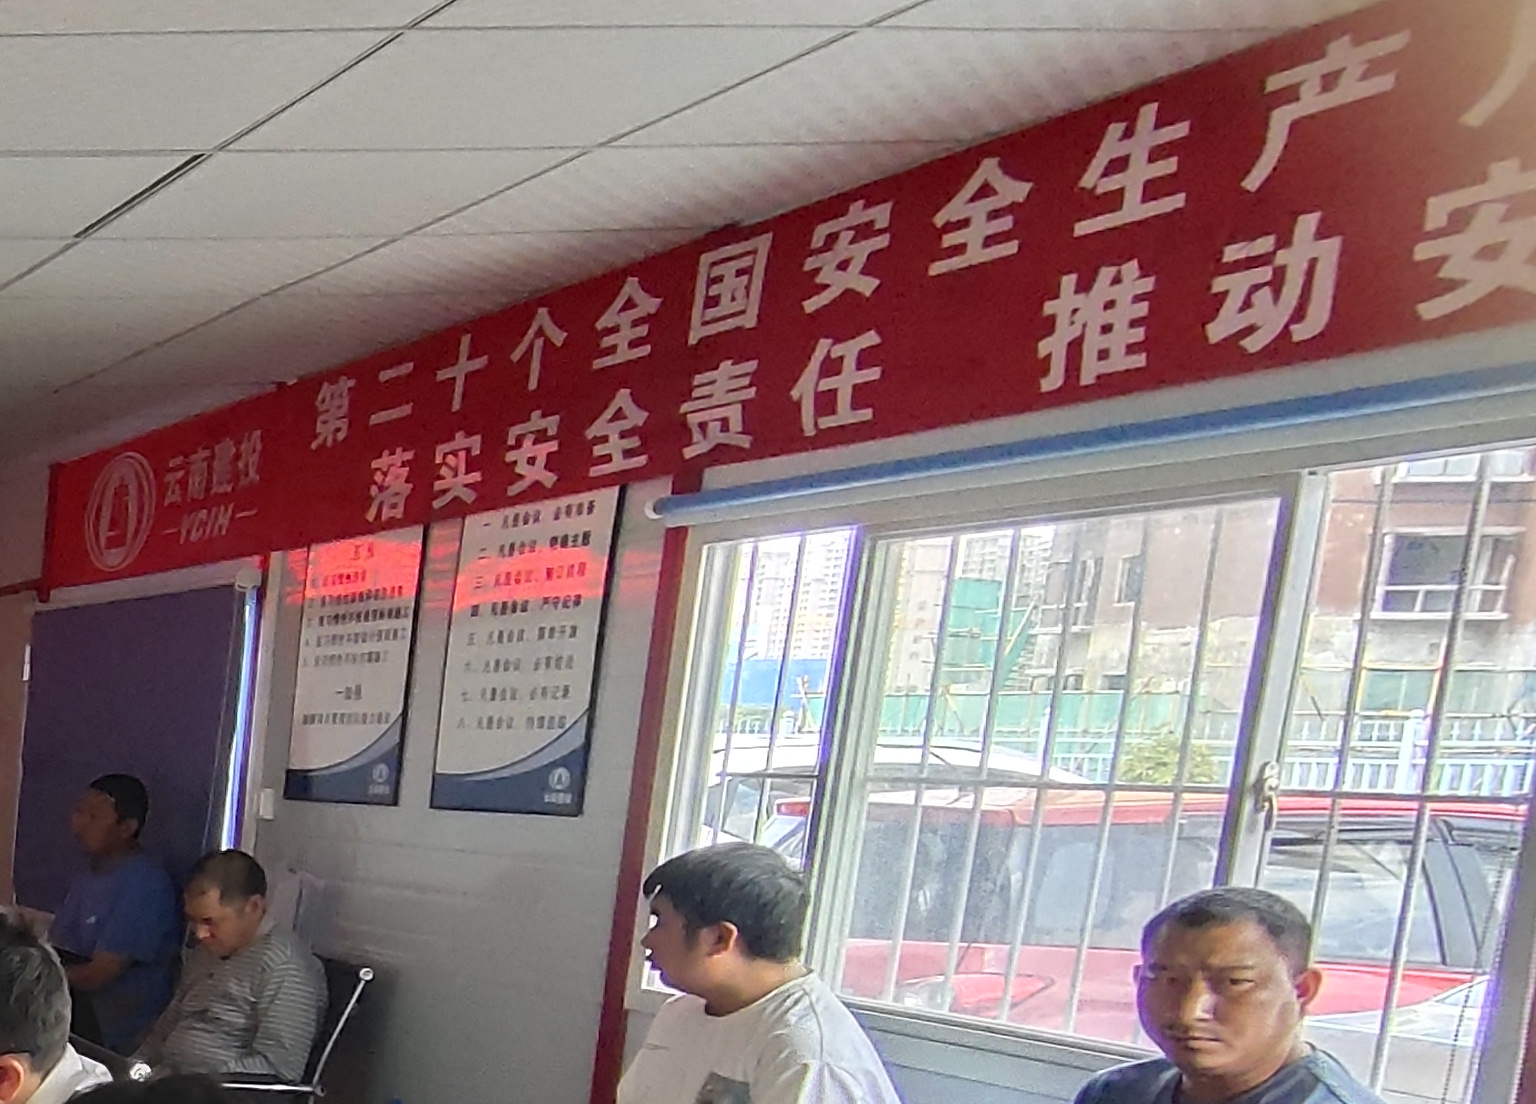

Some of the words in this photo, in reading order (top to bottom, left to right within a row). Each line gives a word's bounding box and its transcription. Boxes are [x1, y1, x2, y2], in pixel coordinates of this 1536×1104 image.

[364, 329, 884, 524] 落实安全责任
[1037, 159, 1536, 393] 推动安
[164, 429, 263, 507] 云南建投
